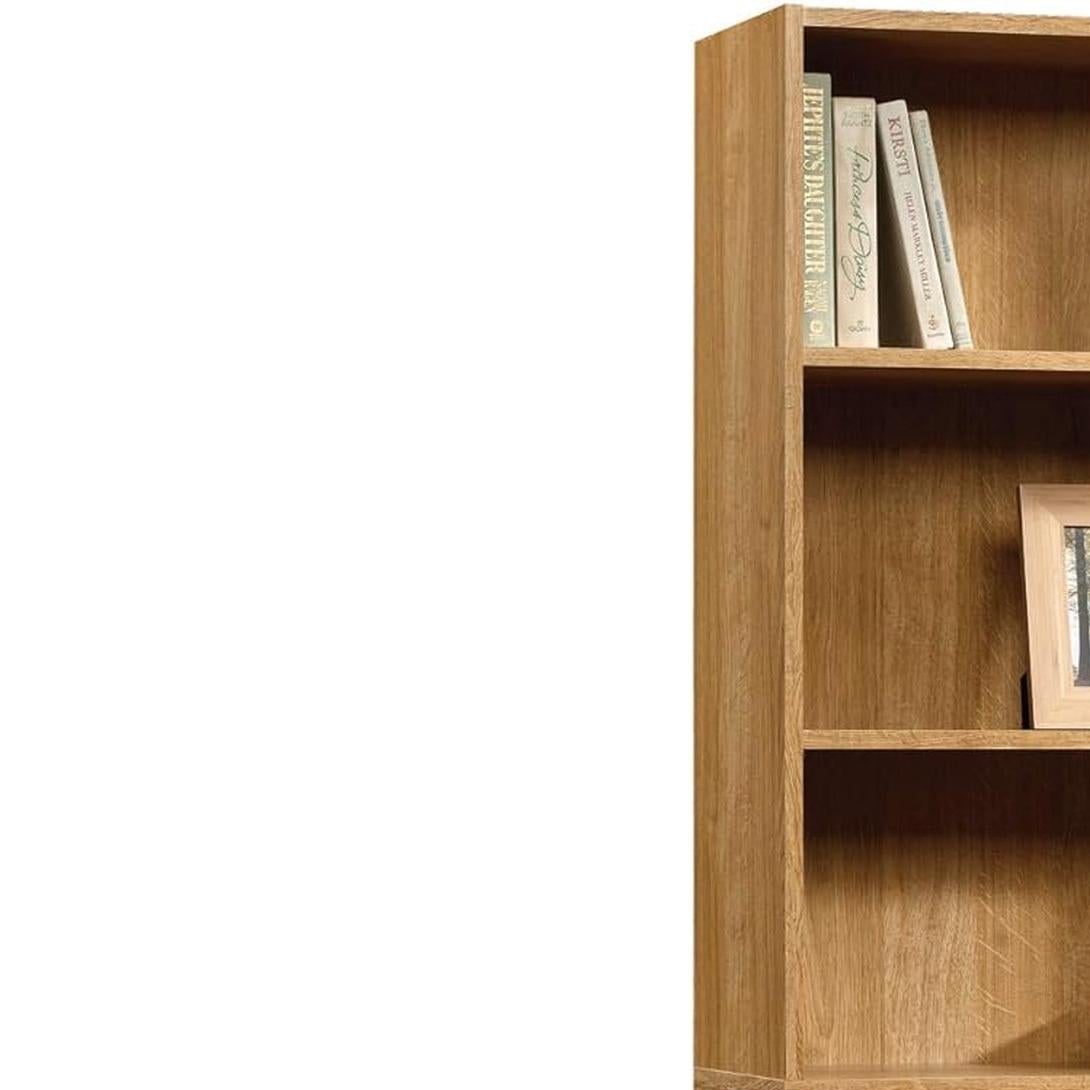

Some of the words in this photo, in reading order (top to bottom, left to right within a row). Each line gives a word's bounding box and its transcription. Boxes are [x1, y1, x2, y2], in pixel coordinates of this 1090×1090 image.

[887, 116, 911, 177] KIRSTI
[803, 174, 826, 274] DAUGHTER
[904, 191, 919, 222] HELEN
[840, 221, 873, 301] Daisy
